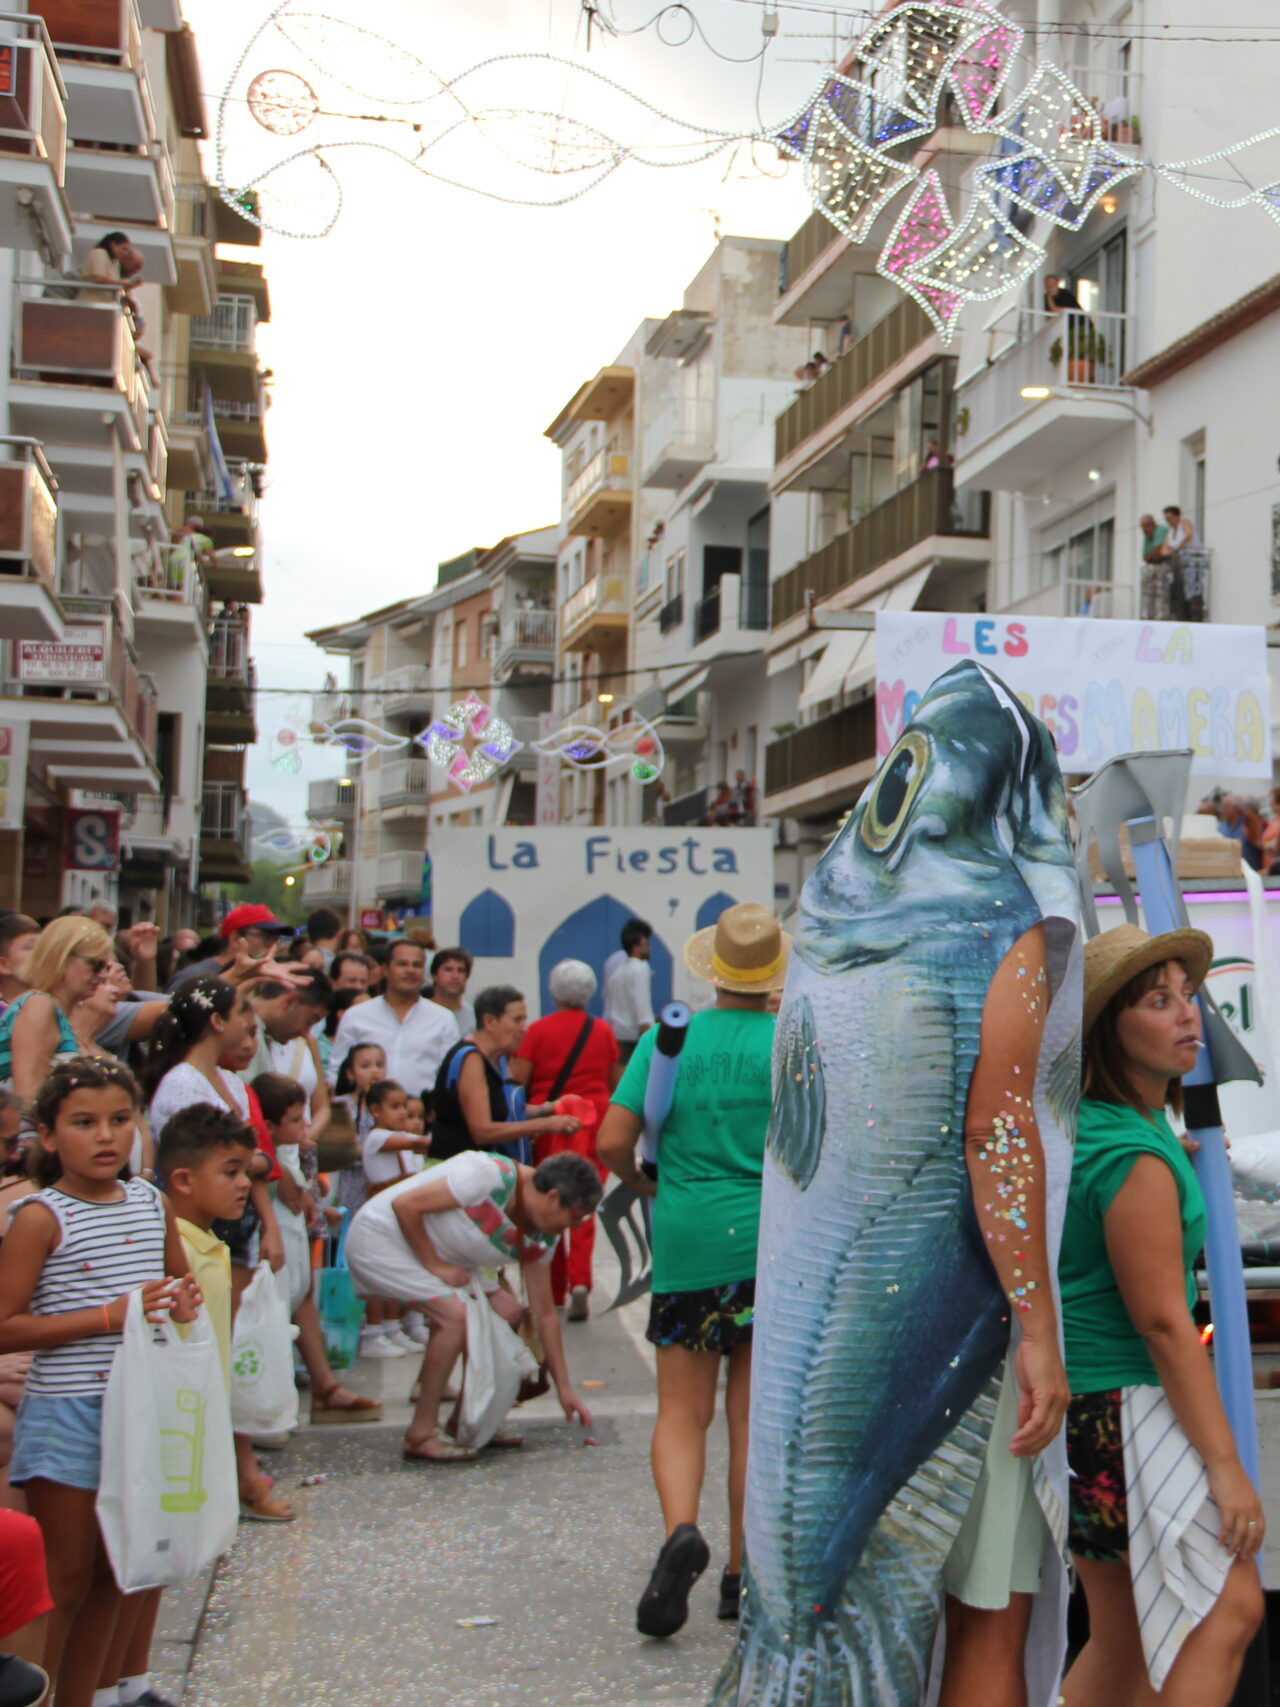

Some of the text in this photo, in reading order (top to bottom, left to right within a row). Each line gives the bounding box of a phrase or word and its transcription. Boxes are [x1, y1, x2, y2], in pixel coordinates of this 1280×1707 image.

[942, 618, 1029, 657] LES
[1136, 626, 1193, 664] LA
[1082, 679, 1265, 763] MAMERA
[487, 834, 739, 875] La Fiesta
